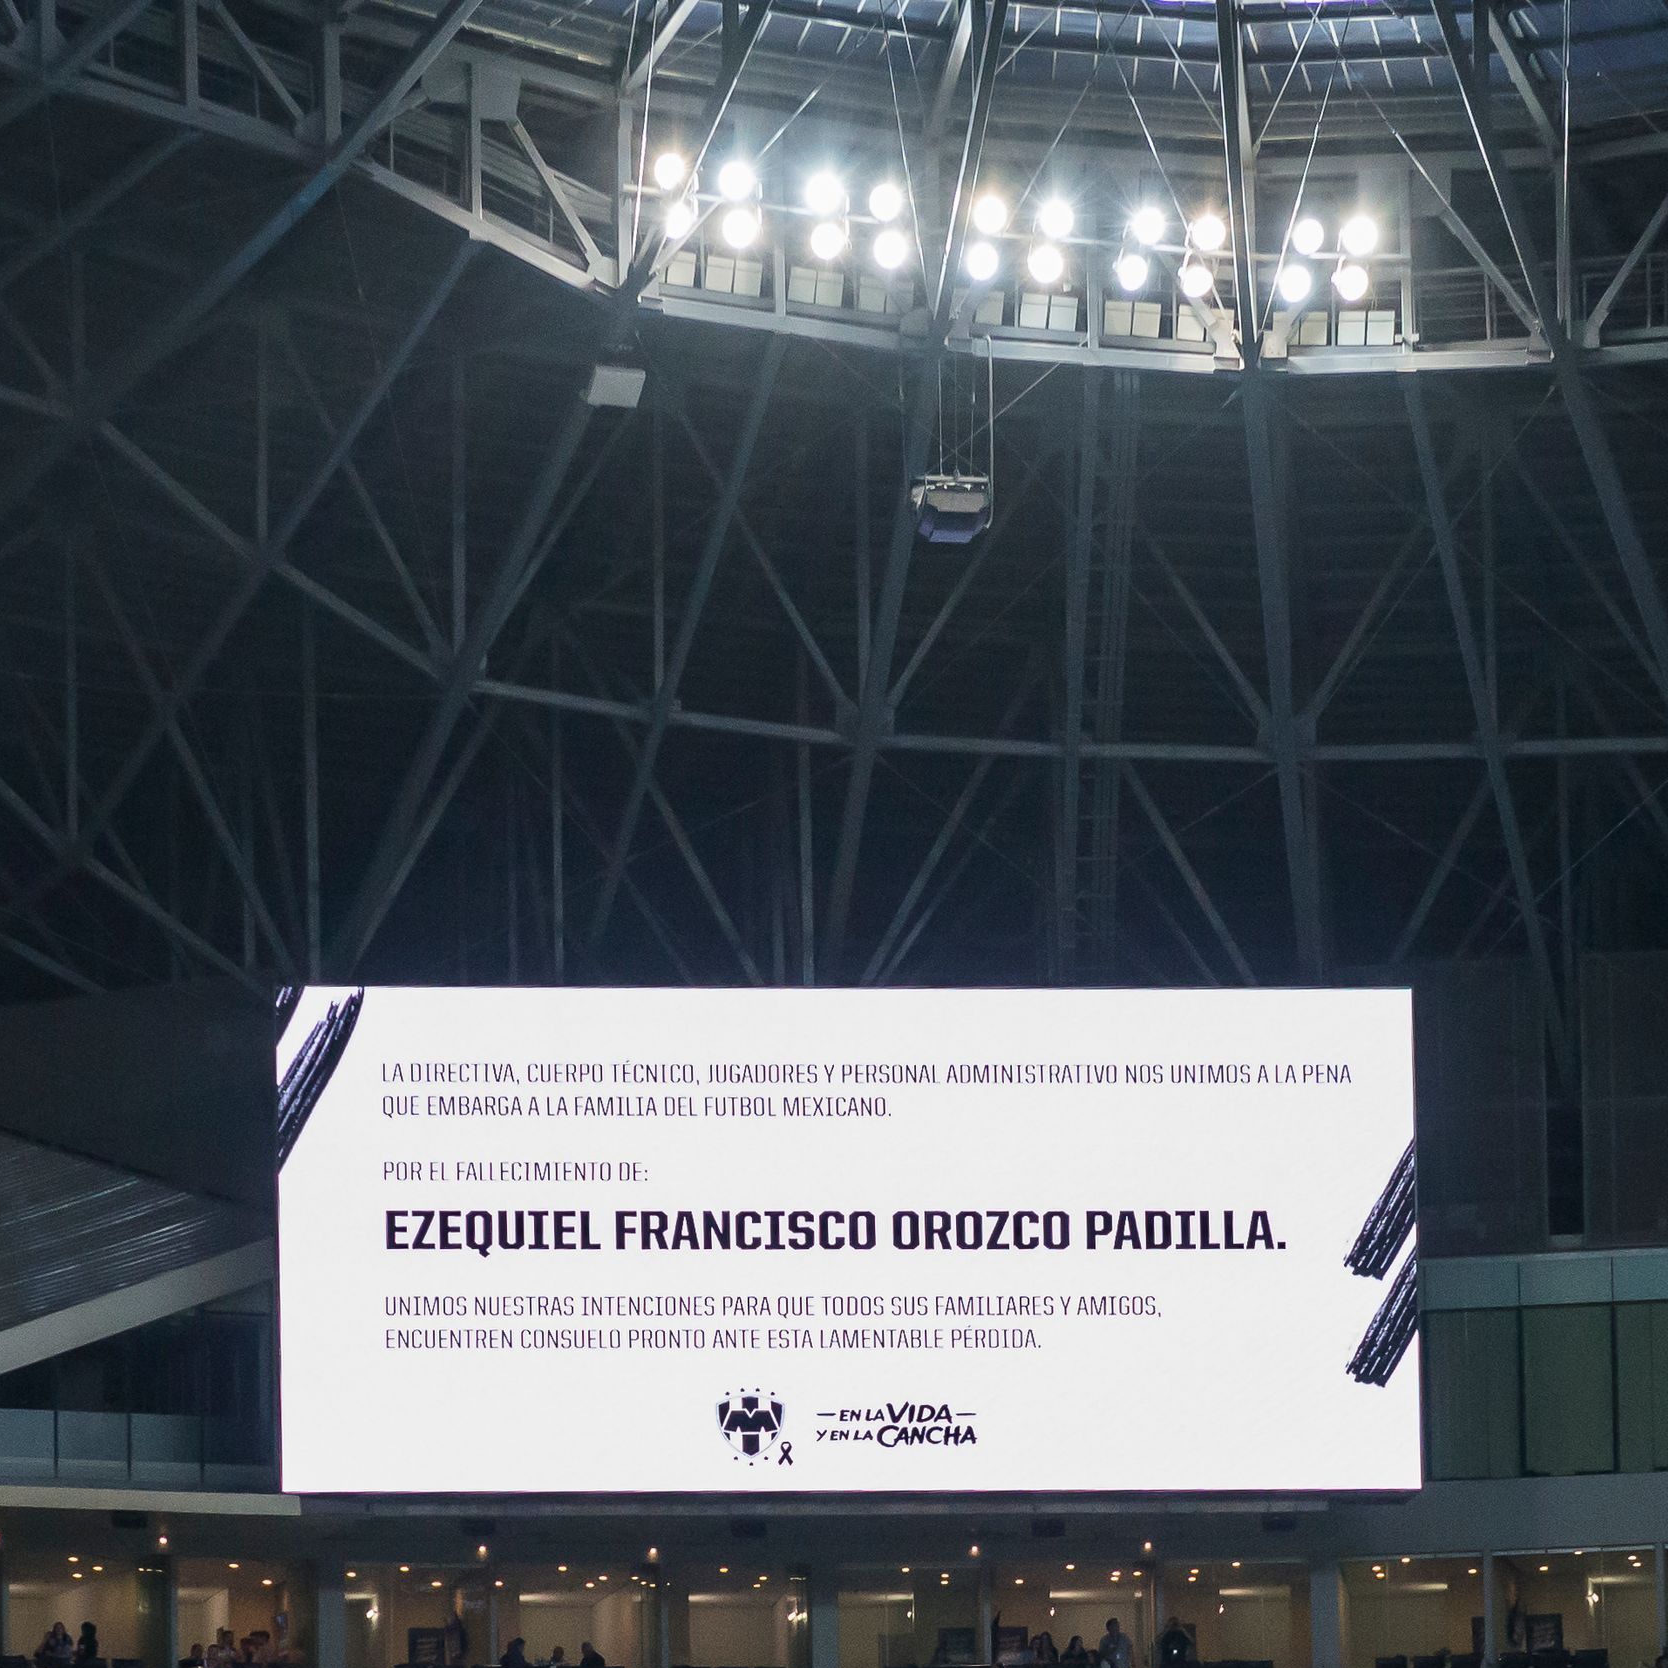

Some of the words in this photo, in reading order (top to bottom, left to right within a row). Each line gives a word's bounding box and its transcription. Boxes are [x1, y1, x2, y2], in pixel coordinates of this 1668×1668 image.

[382, 1062, 405, 1083] LA
[410, 1062, 520, 1086] DIRECTIVA,
[527, 1063, 604, 1084] CUERPO
[612, 1059, 700, 1086] TÉCNICO,
[708, 1063, 818, 1084] JUGADORES
[823, 1063, 835, 1084] Y
[841, 1063, 941, 1084] PERSONAL
[946, 1063, 1118, 1085] ADMINISTRATIVO
[1125, 1064, 1164, 1085] NOS
[1170, 1063, 1251, 1085] UNIMOS
[1257, 1064, 1269, 1084] A
[1274, 1064, 1297, 1084] LA
[1302, 1064, 1352, 1084] PENA
[382, 1095, 420, 1119] QUE
[427, 1095, 523, 1117] EMBARGA
[527, 1096, 540, 1117] A
[546, 1096, 569, 1117] LA
[574, 1095, 658, 1117] FAMILIA
[664, 1096, 698, 1117] DEL
[704, 1096, 777, 1117] FUTBOL
[782, 1096, 892, 1117] MEXICANO.
[383, 1161, 422, 1182] POR
[429, 1161, 451, 1182] EL
[456, 1161, 612, 1182] FALLECIMIENTO
[618, 1161, 648, 1182] DE:
[385, 1209, 602, 1259] EZEQUIEL
[614, 1210, 877, 1251] FRANCISCO
[891, 1210, 1071, 1251] OROZCO
[1085, 1209, 1287, 1251] PADILLA.
[385, 1295, 467, 1317] UNIMOS
[474, 1295, 575, 1317] NUESTRAS
[580, 1295, 715, 1317] INTENCIONES
[722, 1295, 772, 1317] PARA
[777, 1295, 815, 1319] QUE
[820, 1295, 885, 1317] TODOS
[890, 1295, 929, 1317] SUS
[935, 1295, 1055, 1317] FAMILIARES
[1059, 1295, 1072, 1316] Y
[1076, 1295, 1162, 1318] AMIGOS,
[385, 1328, 513, 1349] ENCUENTREN
[520, 1328, 621, 1350] CONSUELO
[628, 1328, 706, 1350] PRONTO
[712, 1328, 761, 1349] ANTE
[767, 1328, 814, 1349] ESTA
[820, 1328, 944, 1349] LAMENTABLE
[951, 1324, 1042, 1349] PÉRDIDA.
[839, 1410, 862, 1421] EN
[865, 1409, 884, 1421] LA
[885, 1401, 952, 1424] VIDA
[816, 1429, 827, 1441] Y
[831, 1429, 849, 1441] EN
[853, 1428, 873, 1441] LA
[876, 1424, 978, 1448] CANCHA
